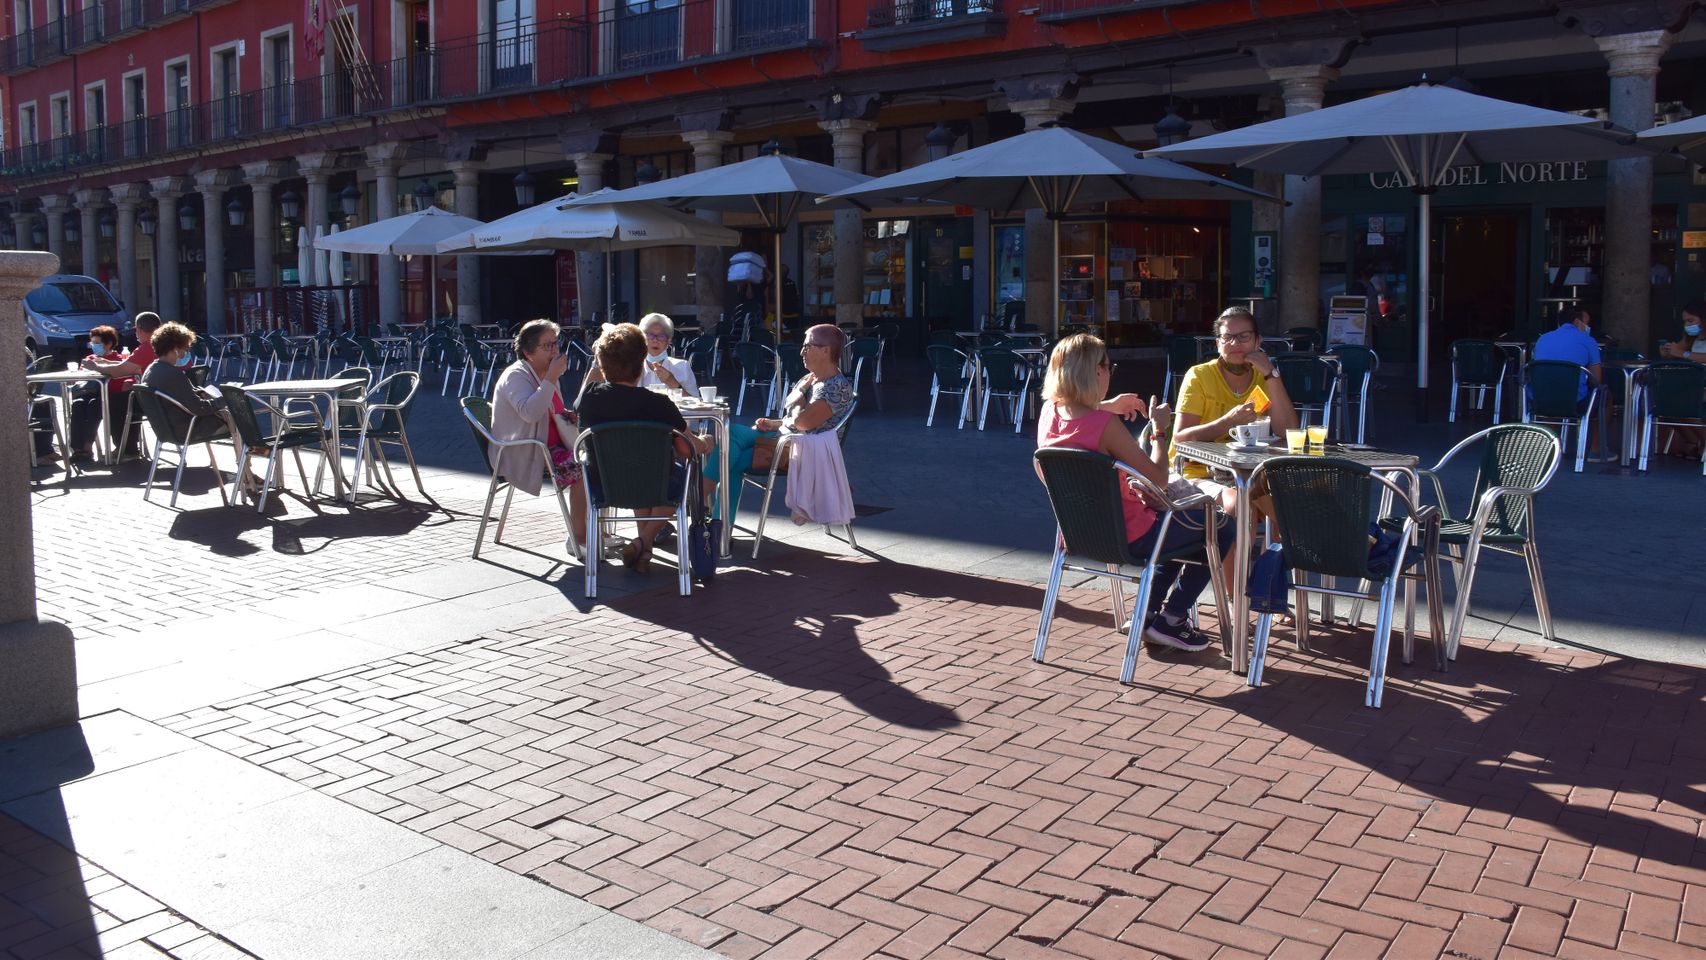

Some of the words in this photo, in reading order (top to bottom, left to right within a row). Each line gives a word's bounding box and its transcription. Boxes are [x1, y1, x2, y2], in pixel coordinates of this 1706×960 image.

[1369, 171, 1418, 190] CA
[1439, 165, 1488, 186] DEL
[1497, 160, 1588, 184] NORTE
